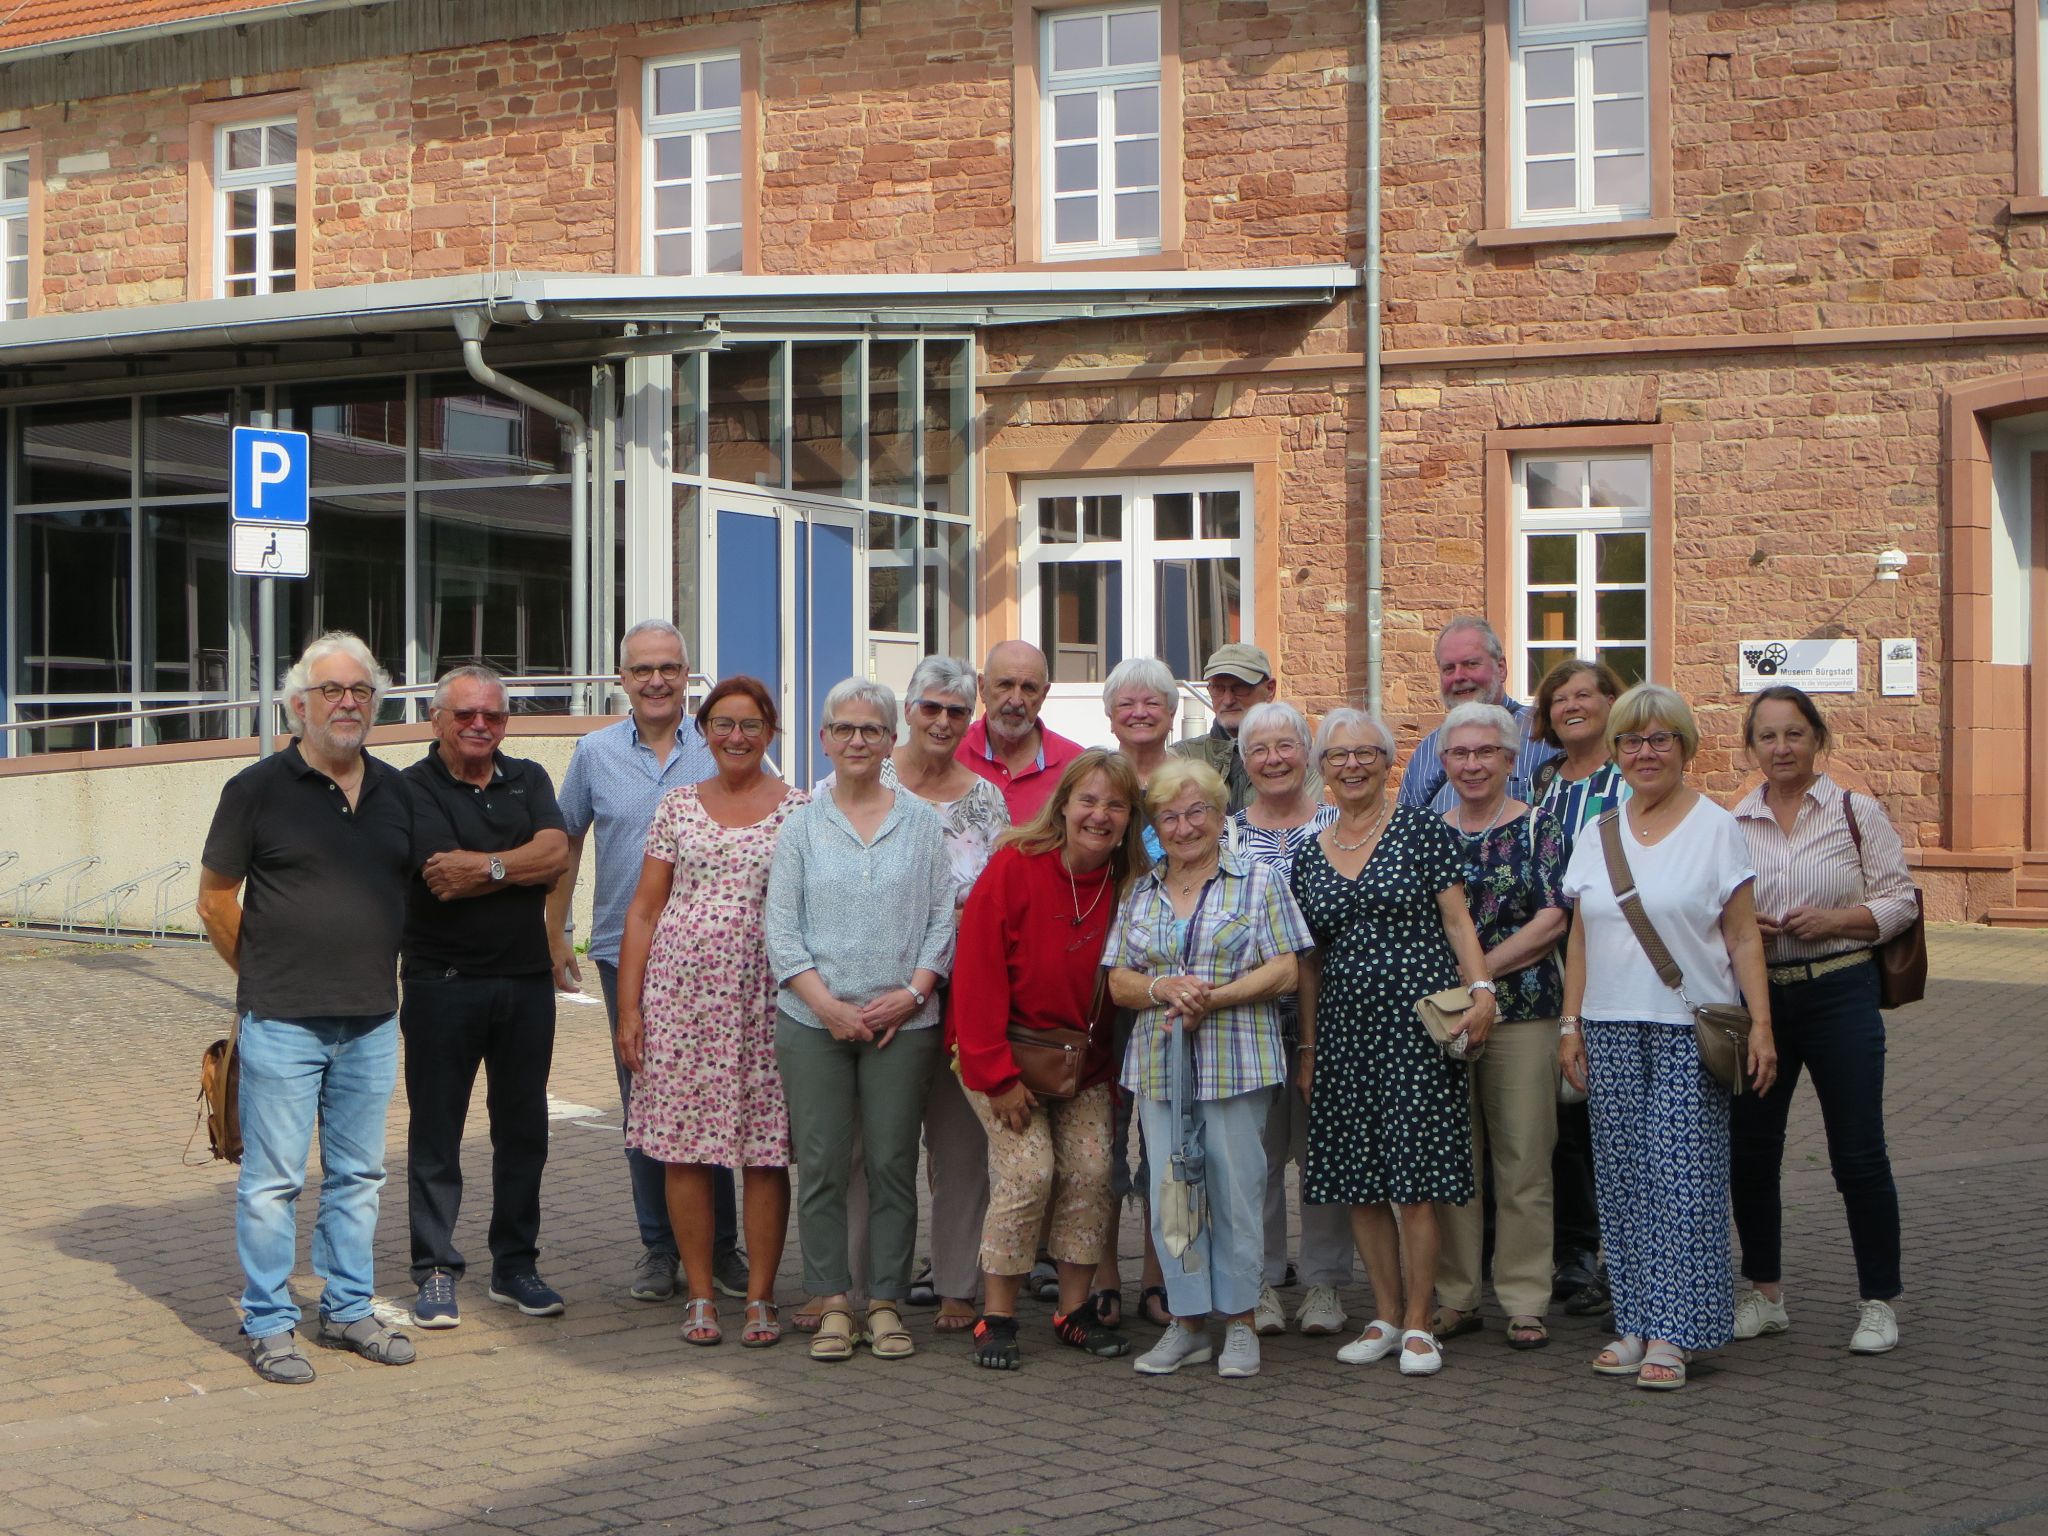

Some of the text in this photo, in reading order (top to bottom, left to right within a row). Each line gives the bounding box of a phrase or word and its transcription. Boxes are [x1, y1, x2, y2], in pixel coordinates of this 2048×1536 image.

[252, 440, 291, 509] P
[1780, 668, 1854, 677] Museum Bürgstadt
